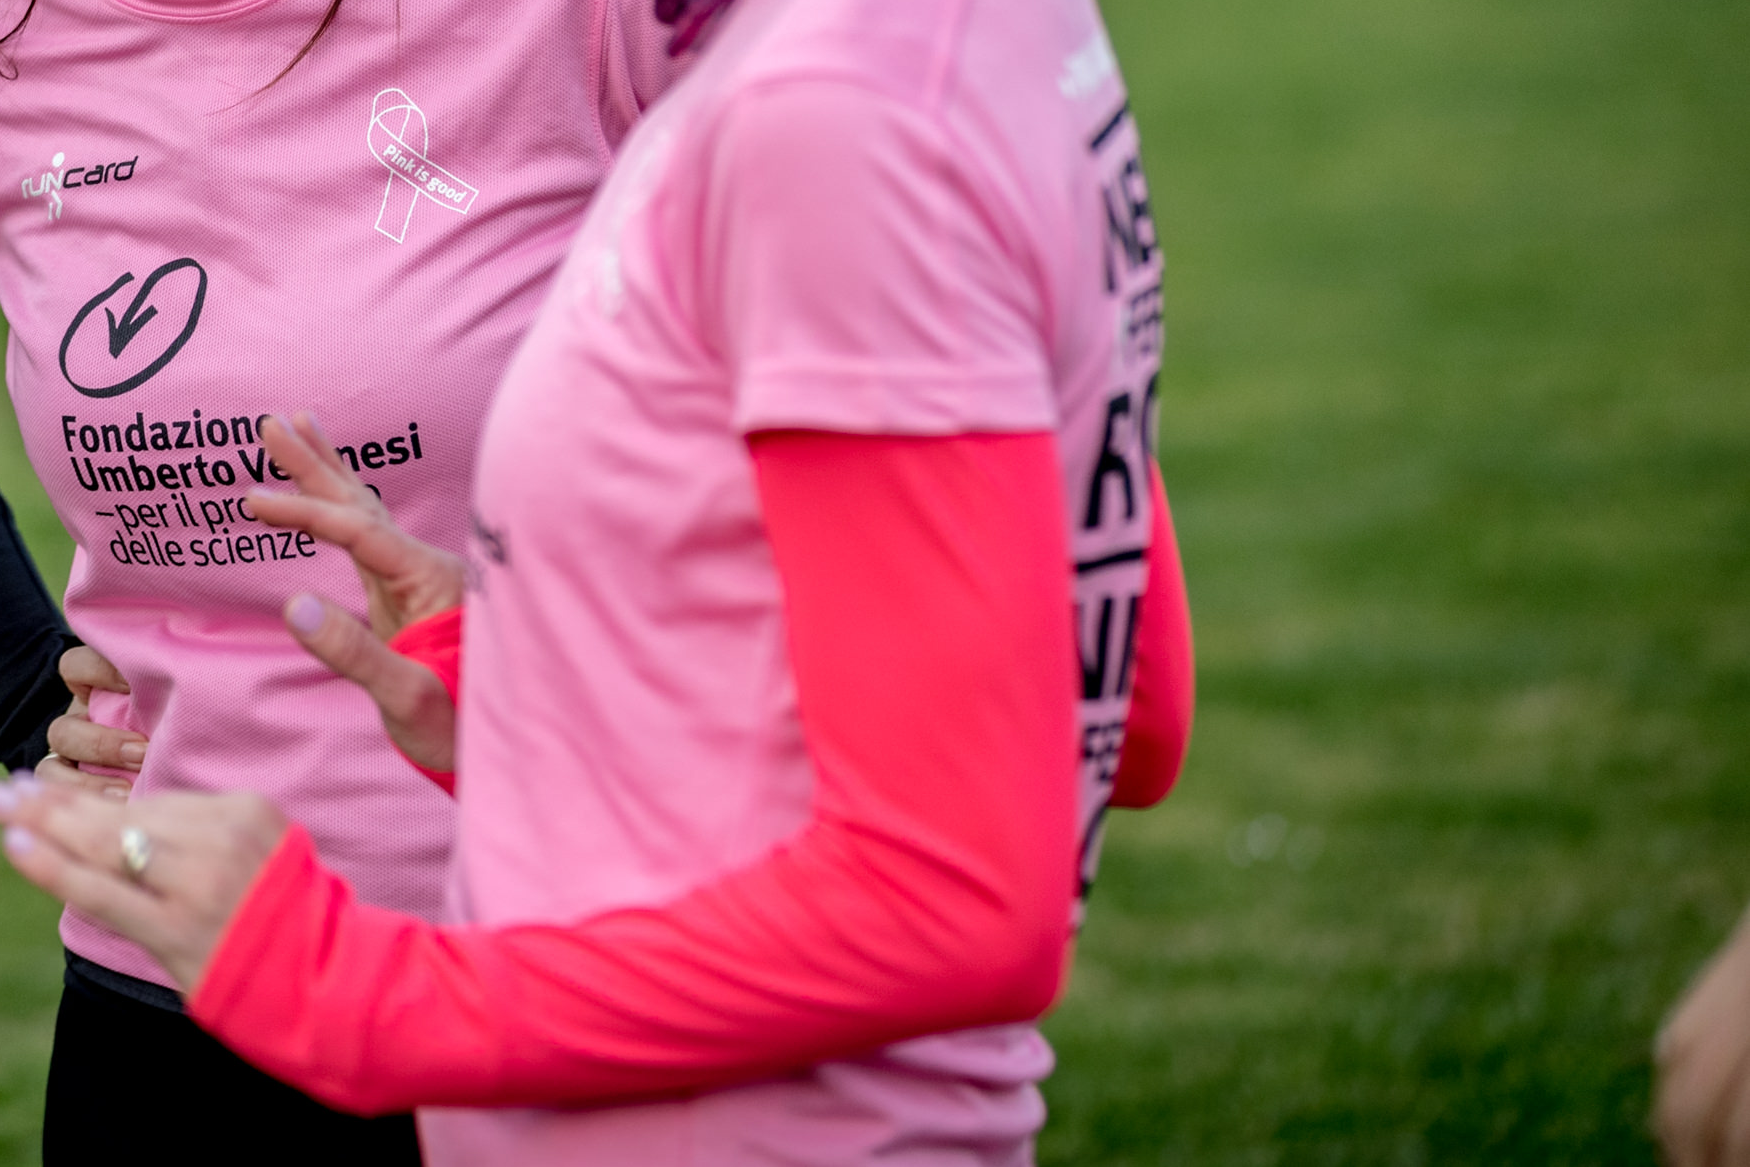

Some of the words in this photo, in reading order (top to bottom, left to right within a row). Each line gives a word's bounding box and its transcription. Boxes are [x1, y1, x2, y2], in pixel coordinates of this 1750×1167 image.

[383, 144, 416, 173] Pink
[414, 165, 430, 182] is
[426, 177, 467, 203] good
[70, 454, 236, 492] Umberto
[170, 492, 199, 527] il
[110, 530, 186, 567] delle
[189, 527, 316, 567] scienze
